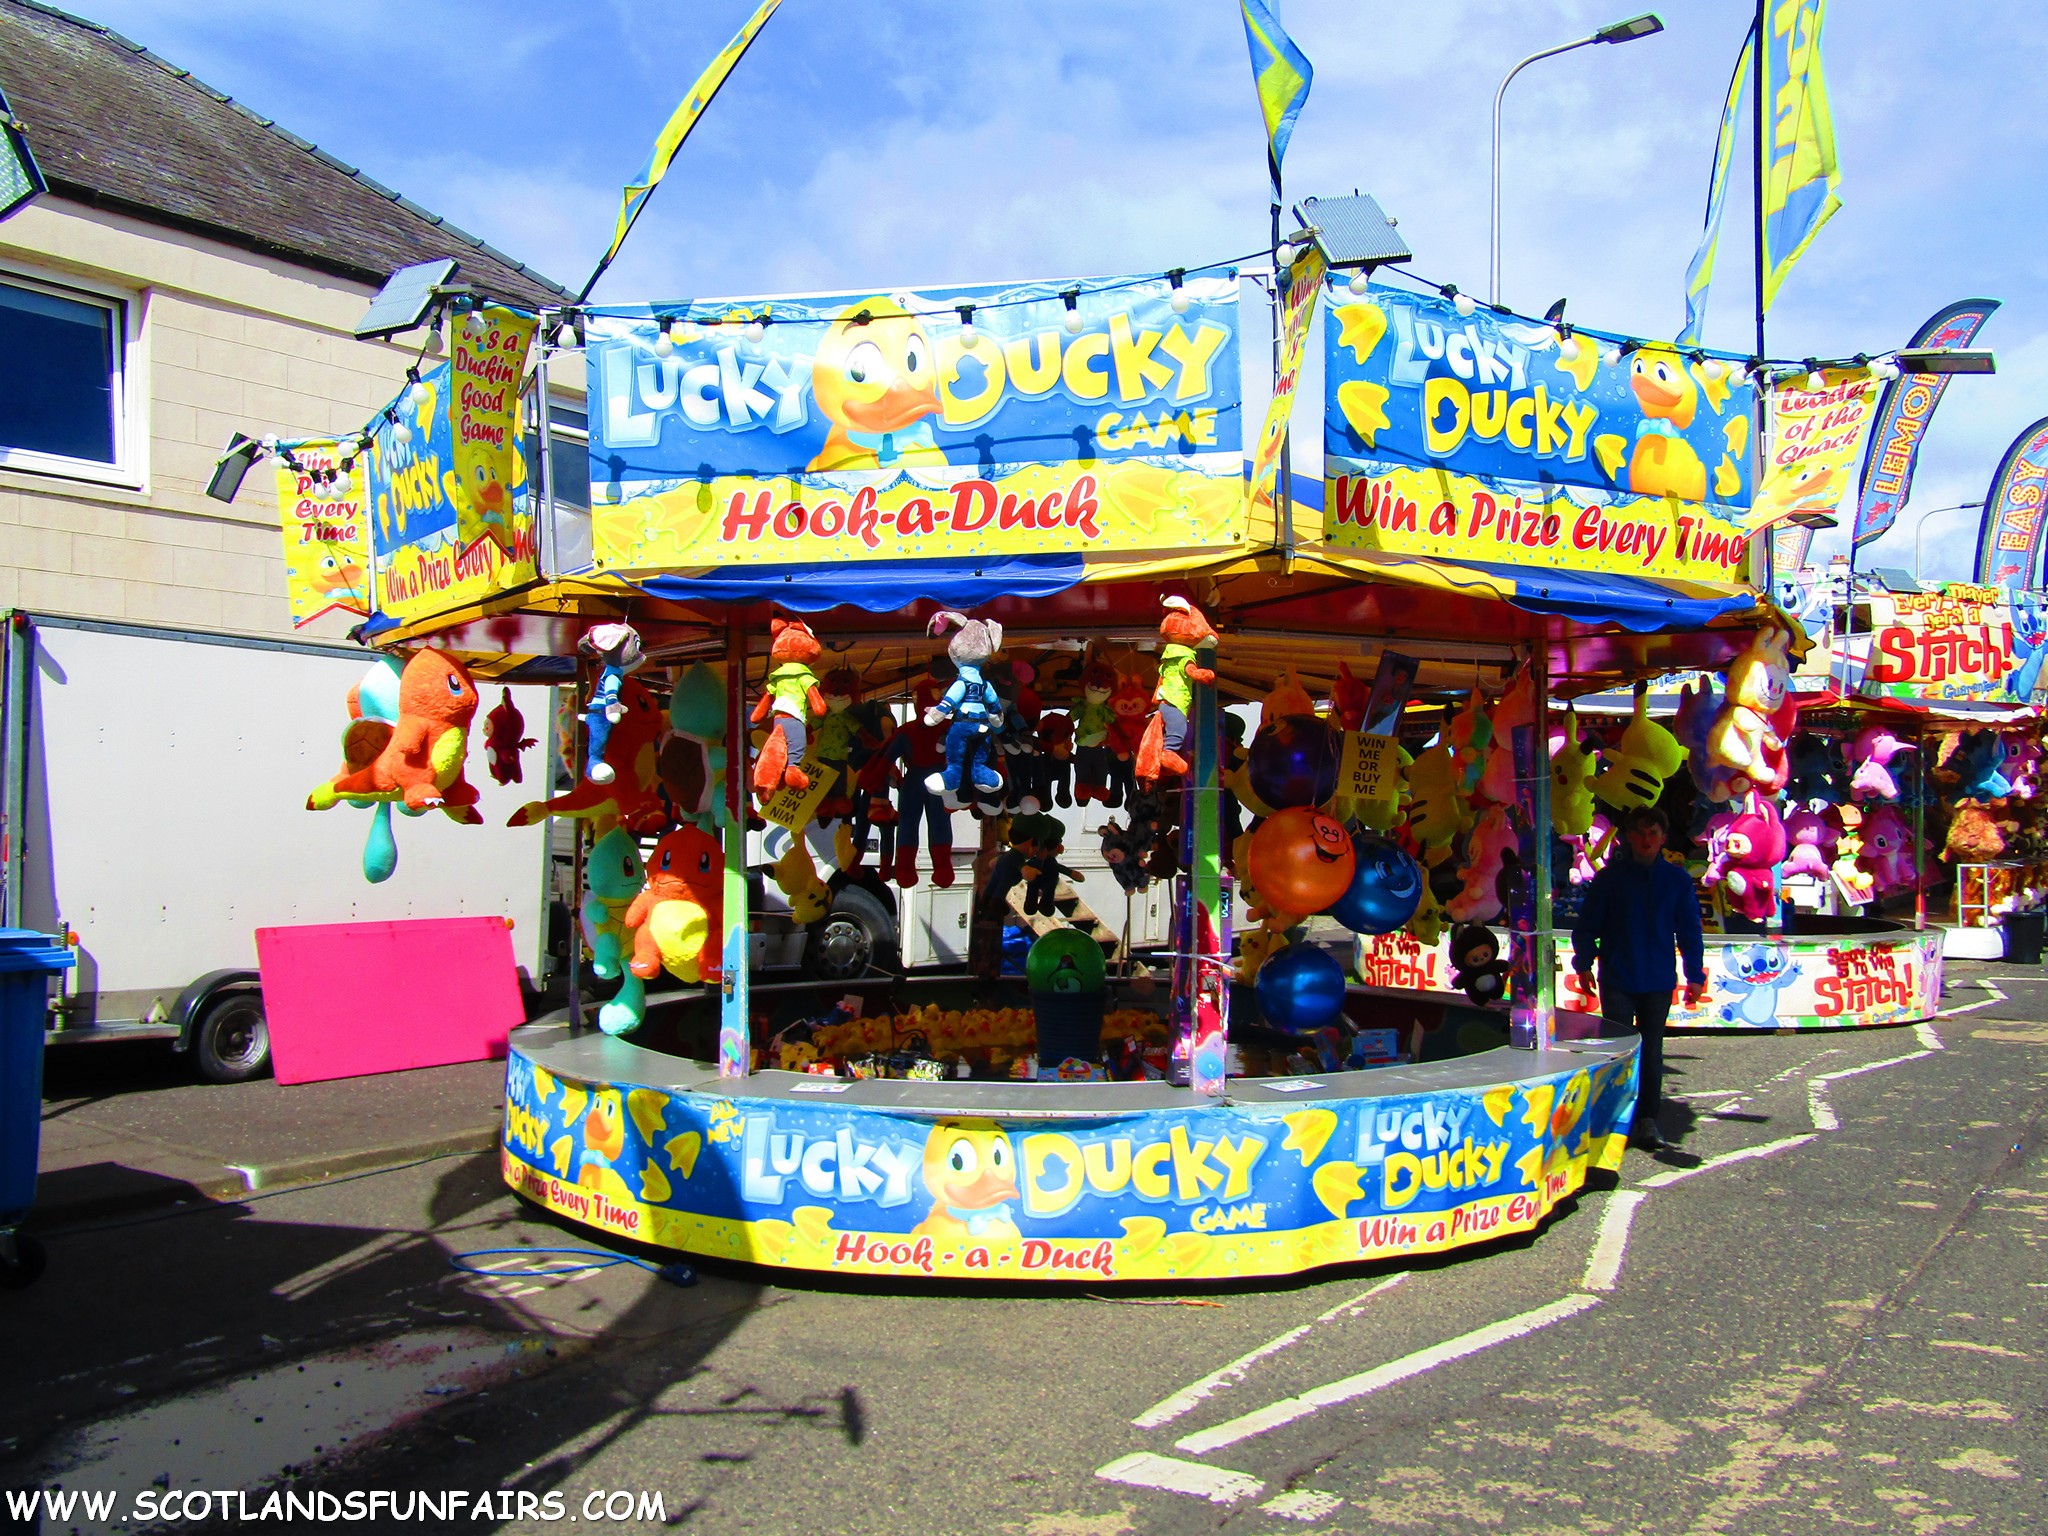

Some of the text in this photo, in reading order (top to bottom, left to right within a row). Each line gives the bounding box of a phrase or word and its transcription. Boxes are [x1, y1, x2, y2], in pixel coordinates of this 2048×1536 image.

[503, 335, 518, 352] a
[456, 346, 520, 385] Duckin'
[460, 381, 505, 412] Good
[1781, 379, 1871, 412] Leader
[460, 414, 504, 444] Game
[1094, 408, 1218, 450] GAME
[1785, 406, 1862, 441] of the
[1776, 425, 1860, 464] Quack
[295, 500, 358, 520] Every
[722, 475, 1101, 547] Hook-a-Duck
[1997, 458, 2048, 552] EASY
[302, 523, 356, 544] Time
[1336, 474, 1417, 533] Win
[1429, 498, 1456, 536] a
[1468, 493, 1561, 547] Prize
[1573, 507, 1668, 567] Every
[1676, 517, 1744, 569] Time
[386, 565, 407, 603] Win
[409, 574, 419, 596] a
[417, 551, 451, 592] Prize
[453, 540, 492, 583] Every
[1893, 583, 1999, 615] Every Player
[1968, 607, 1980, 625] a
[1873, 622, 2013, 682] Stitch!
[1357, 736, 1386, 749] WIN
[1359, 749, 1380, 760] ME
[802, 763, 824, 778] ME
[1353, 772, 1381, 784] BUY
[1358, 760, 1378, 772] OR
[779, 796, 800, 812] ME
[1354, 783, 1377, 795] ME
[770, 806, 795, 825] WIN
[1365, 953, 1437, 990] Stitch!
[1814, 963, 1914, 1017] Stitch!
[707, 1116, 746, 1144] NEW
[551, 1179, 590, 1219] Every
[594, 1194, 638, 1230] Time
[1191, 1204, 1267, 1231] GAME
[1358, 1218, 1417, 1249] Win
[1425, 1220, 1445, 1242] a
[1451, 1204, 1500, 1239] Prize
[836, 1232, 933, 1273] Hook
[965, 1246, 988, 1268] a
[1021, 1241, 1113, 1278] Duck
